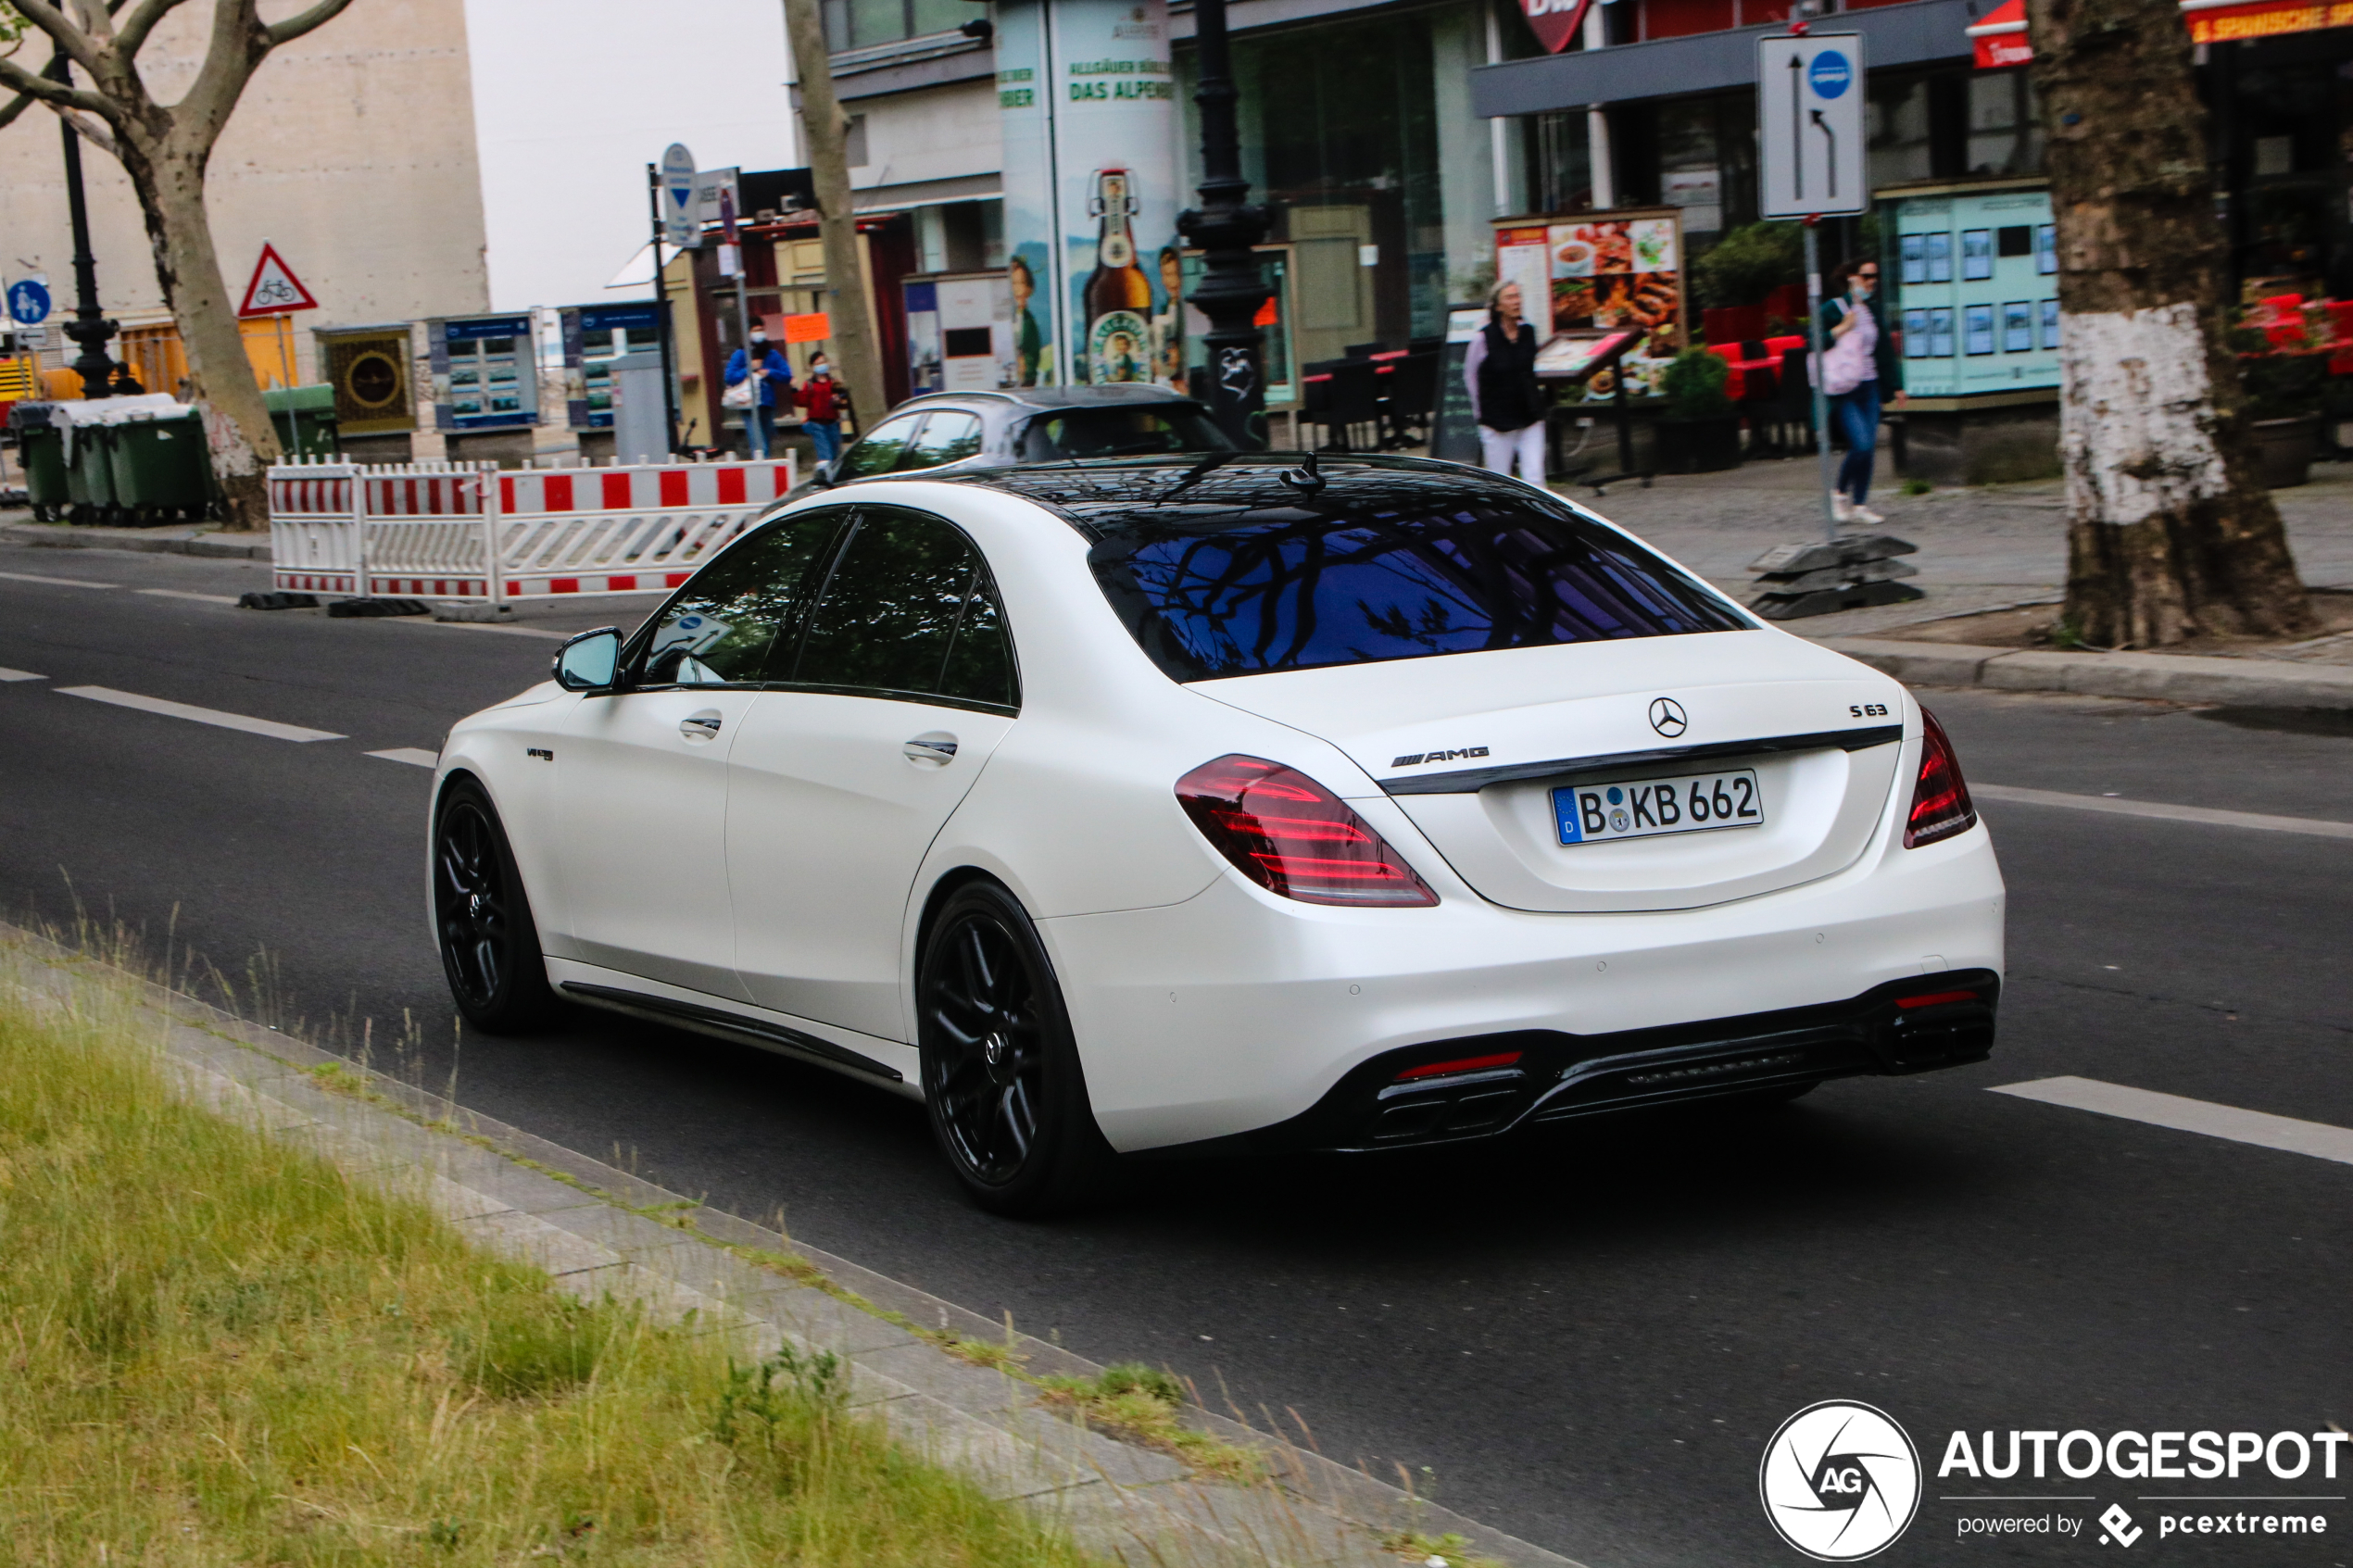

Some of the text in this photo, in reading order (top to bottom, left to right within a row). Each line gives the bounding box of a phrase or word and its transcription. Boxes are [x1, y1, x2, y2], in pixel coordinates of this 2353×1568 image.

[1069, 82, 1108, 101] DAS
[1849, 704, 1888, 718] S 63
[1424, 746, 1490, 764] AMG
[1579, 776, 1757, 834] B KB 662
[1564, 820, 1574, 834] D
